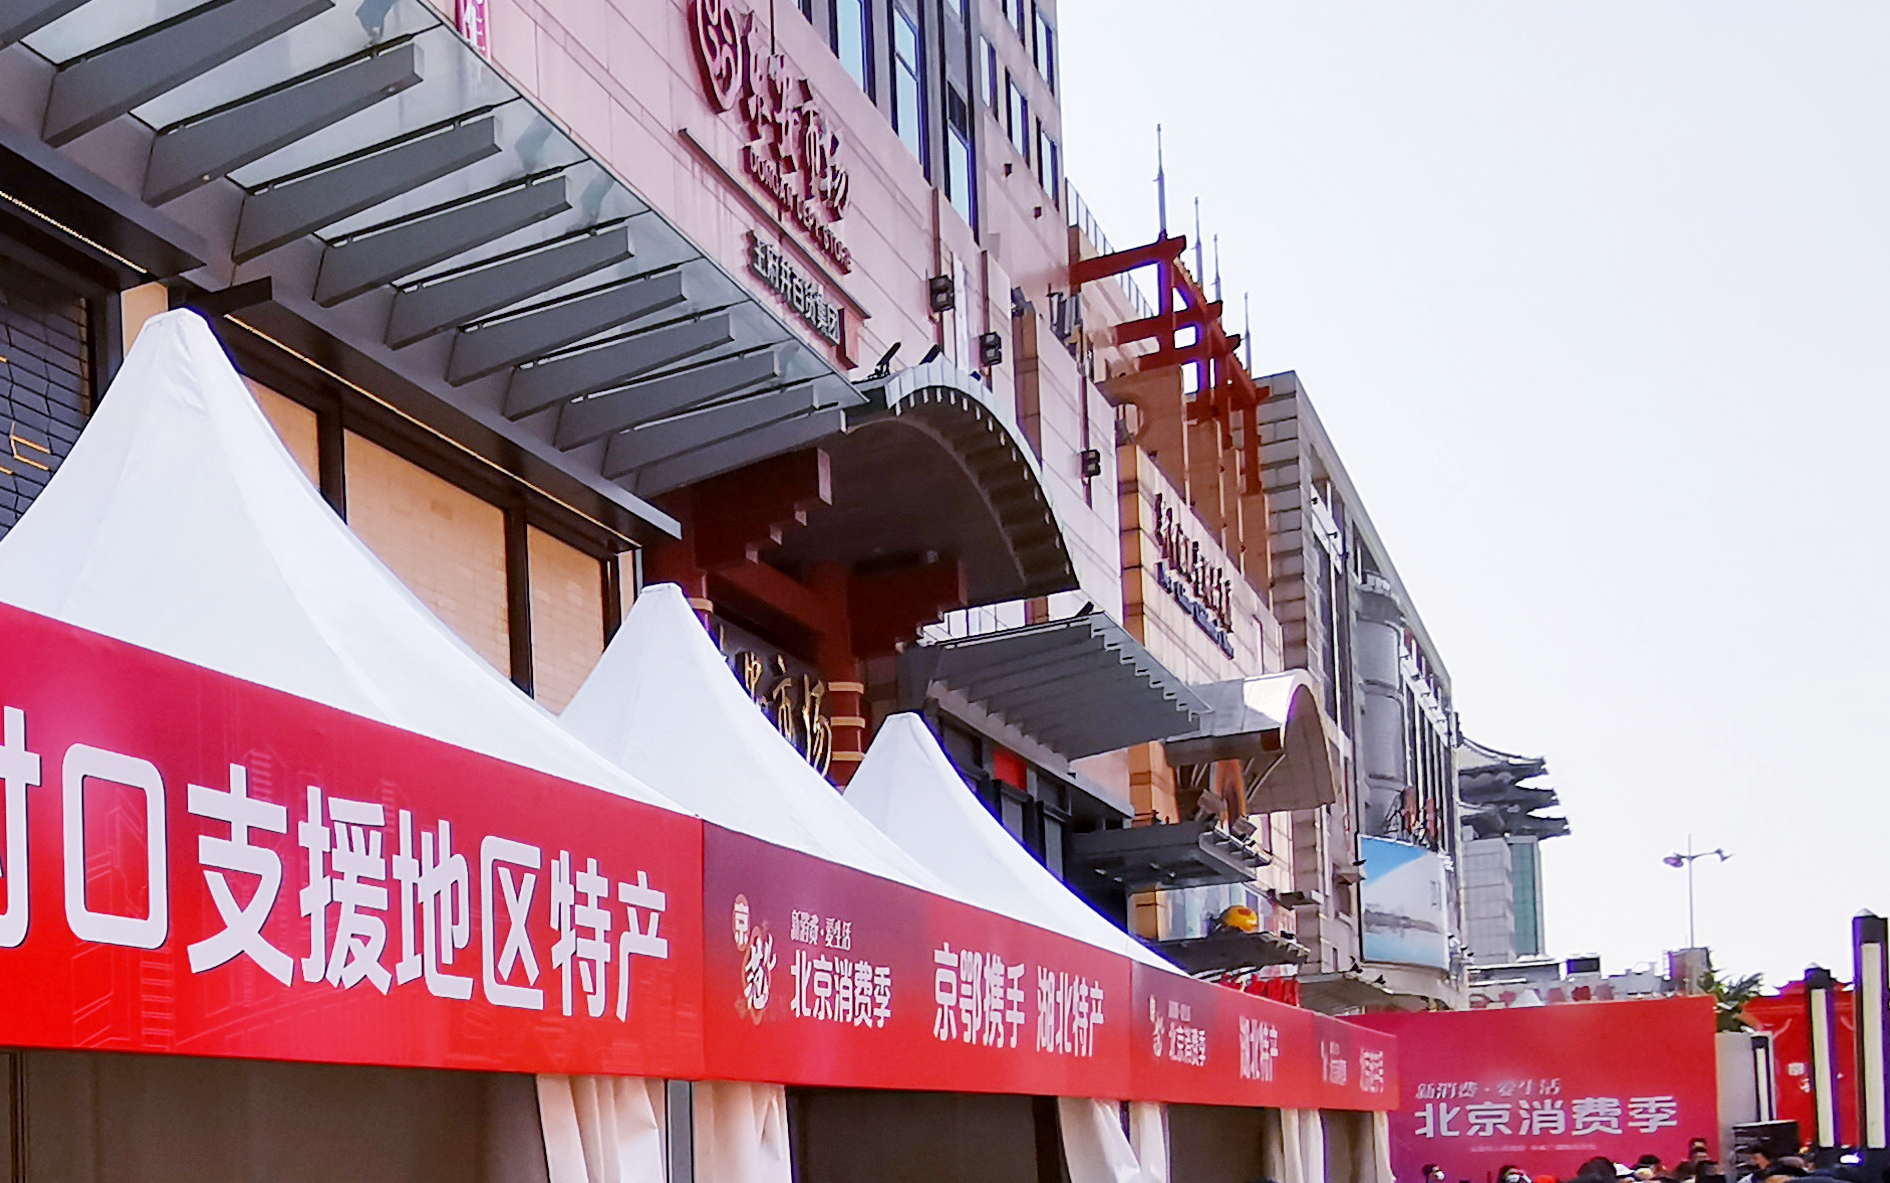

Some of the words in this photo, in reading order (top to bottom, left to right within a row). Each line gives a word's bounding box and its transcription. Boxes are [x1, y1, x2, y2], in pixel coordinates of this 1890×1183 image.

[790, 949, 892, 1029] 北京消费季
[932, 941, 1026, 1049] 京鄂携手
[1036, 964, 1105, 1057] 湖北特产
[1414, 1095, 1678, 1139] 北京消费季
